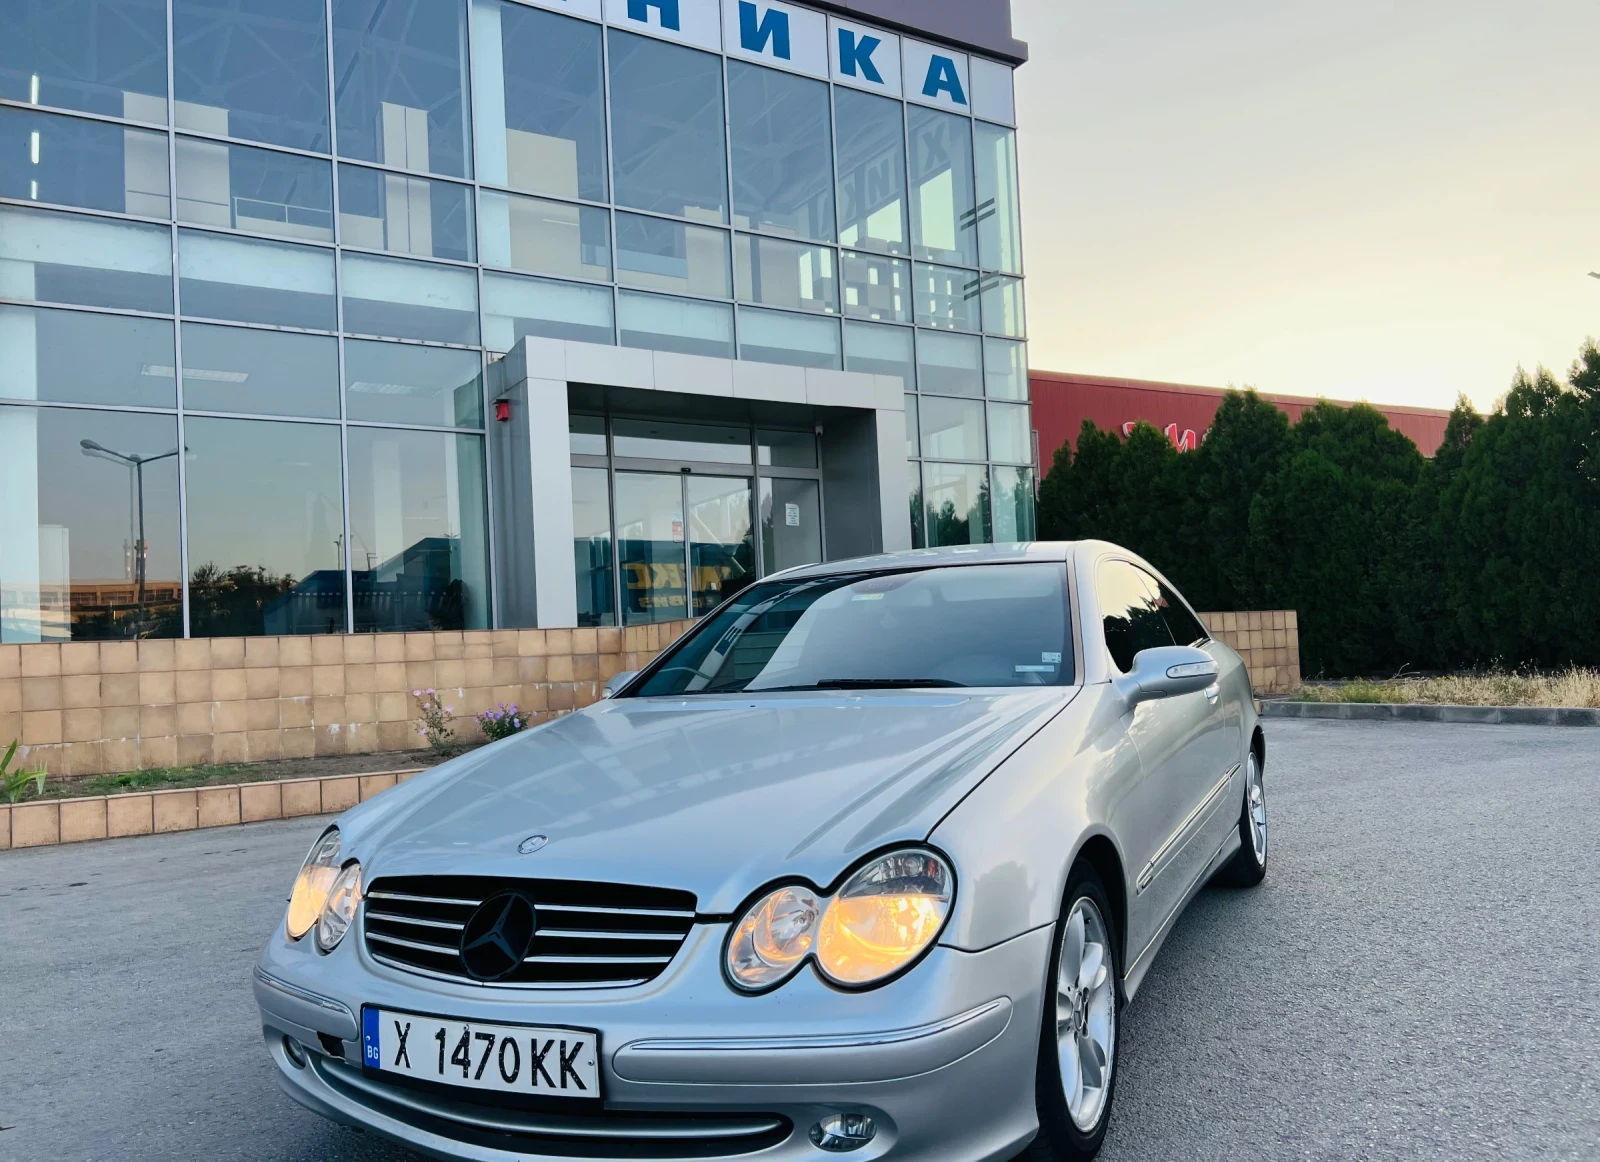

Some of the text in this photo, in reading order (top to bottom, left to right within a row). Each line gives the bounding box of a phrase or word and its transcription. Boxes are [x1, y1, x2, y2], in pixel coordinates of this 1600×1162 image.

[367, 1045, 379, 1060] BG
[394, 1020, 411, 1069] X
[435, 1027, 521, 1084] 1470
